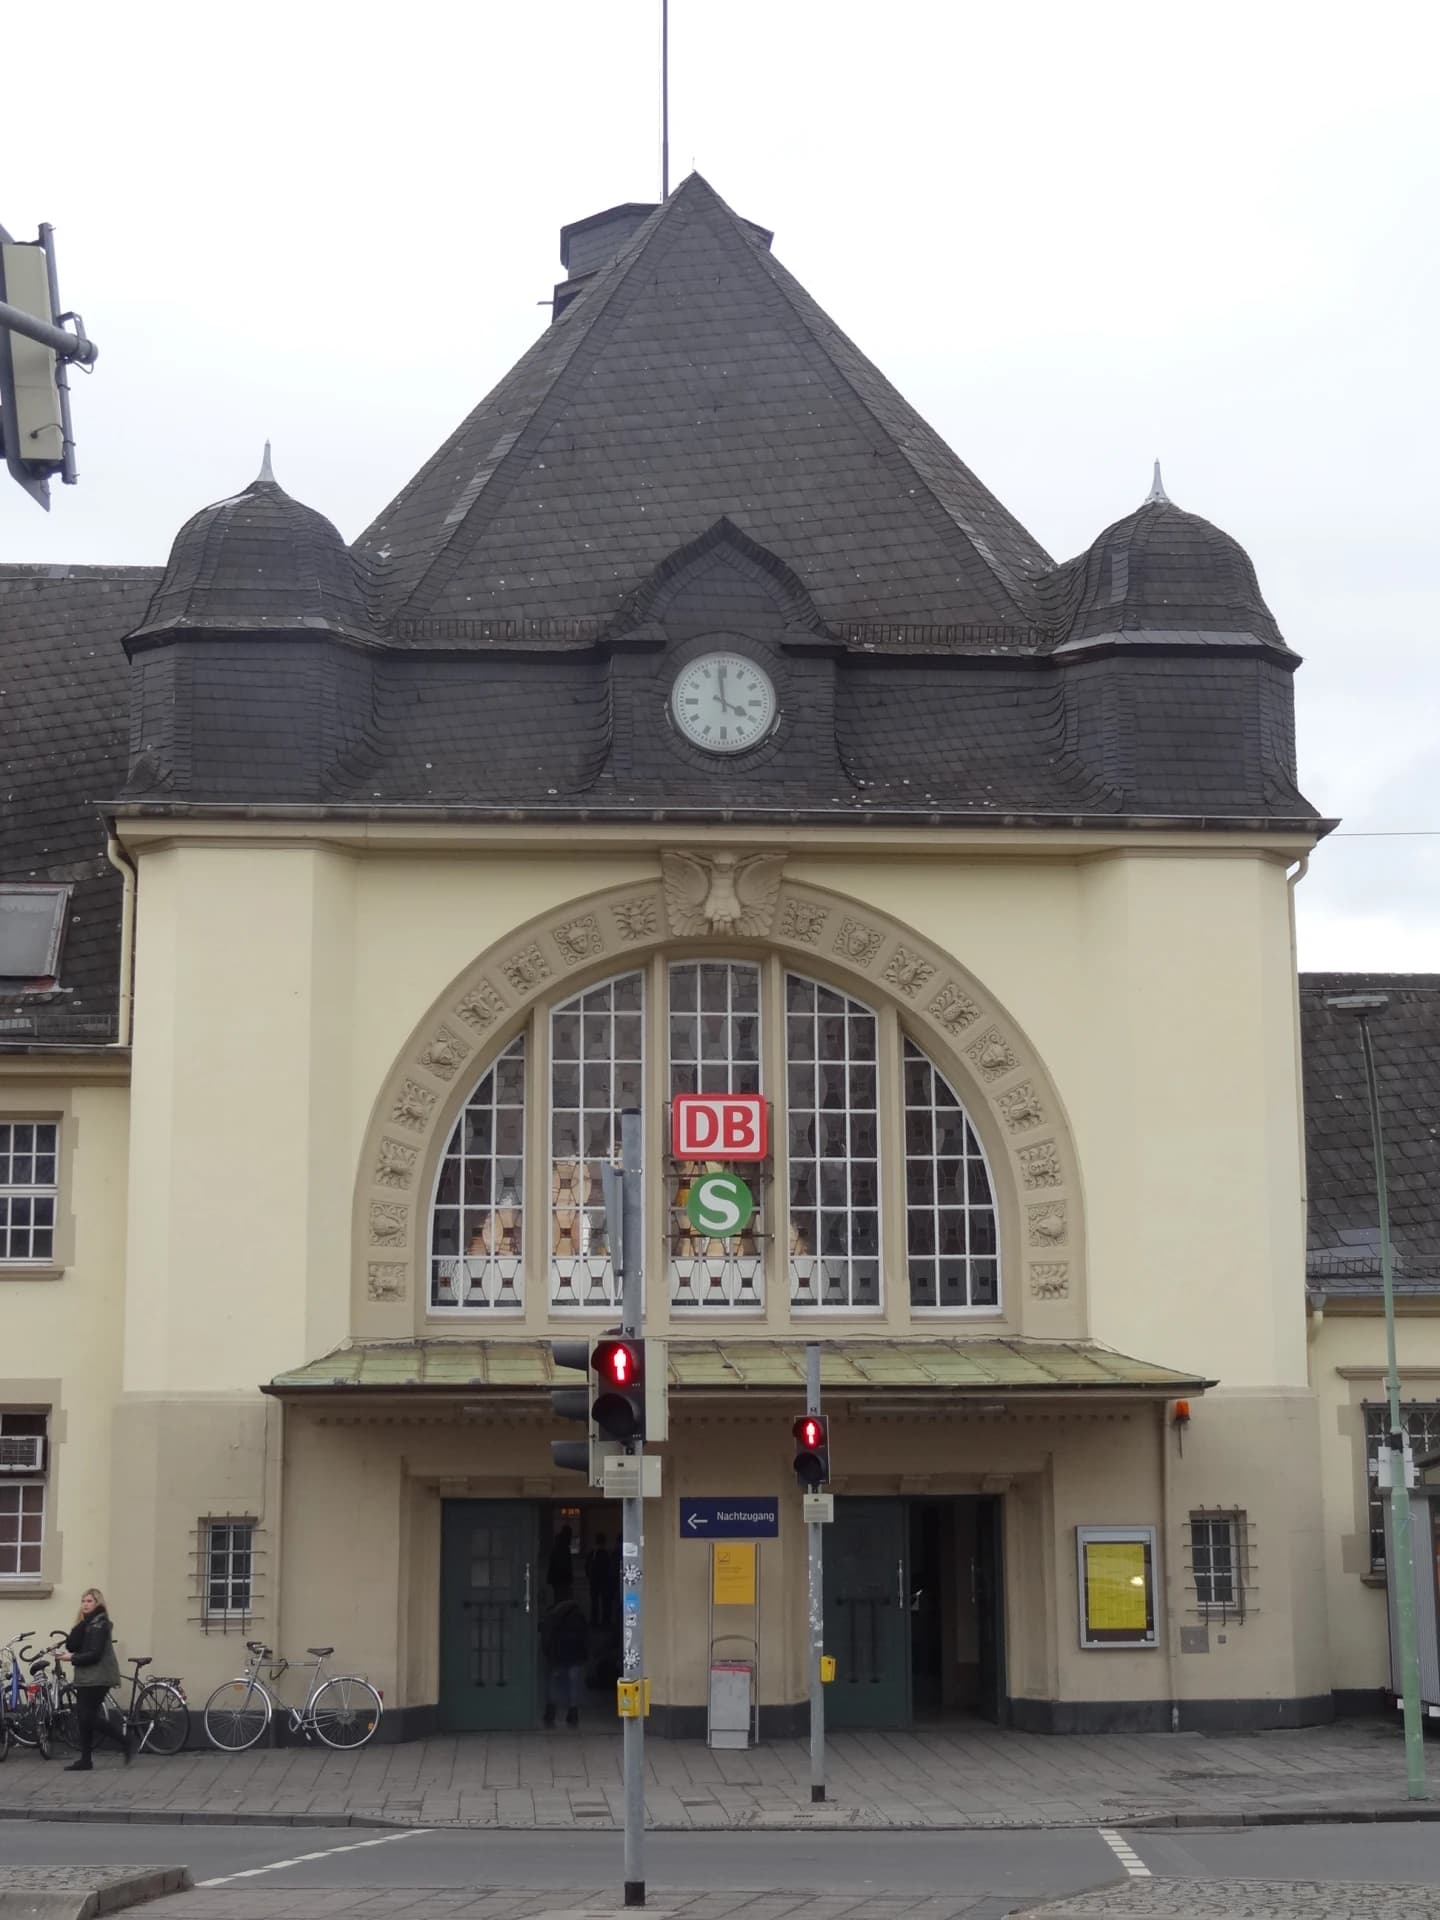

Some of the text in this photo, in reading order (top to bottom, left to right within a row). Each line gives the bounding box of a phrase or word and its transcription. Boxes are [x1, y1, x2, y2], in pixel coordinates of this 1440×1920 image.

[686, 1105, 755, 1149] DB
[699, 1178, 740, 1231] S
[716, 1511, 775, 1523] Nachtzugang
